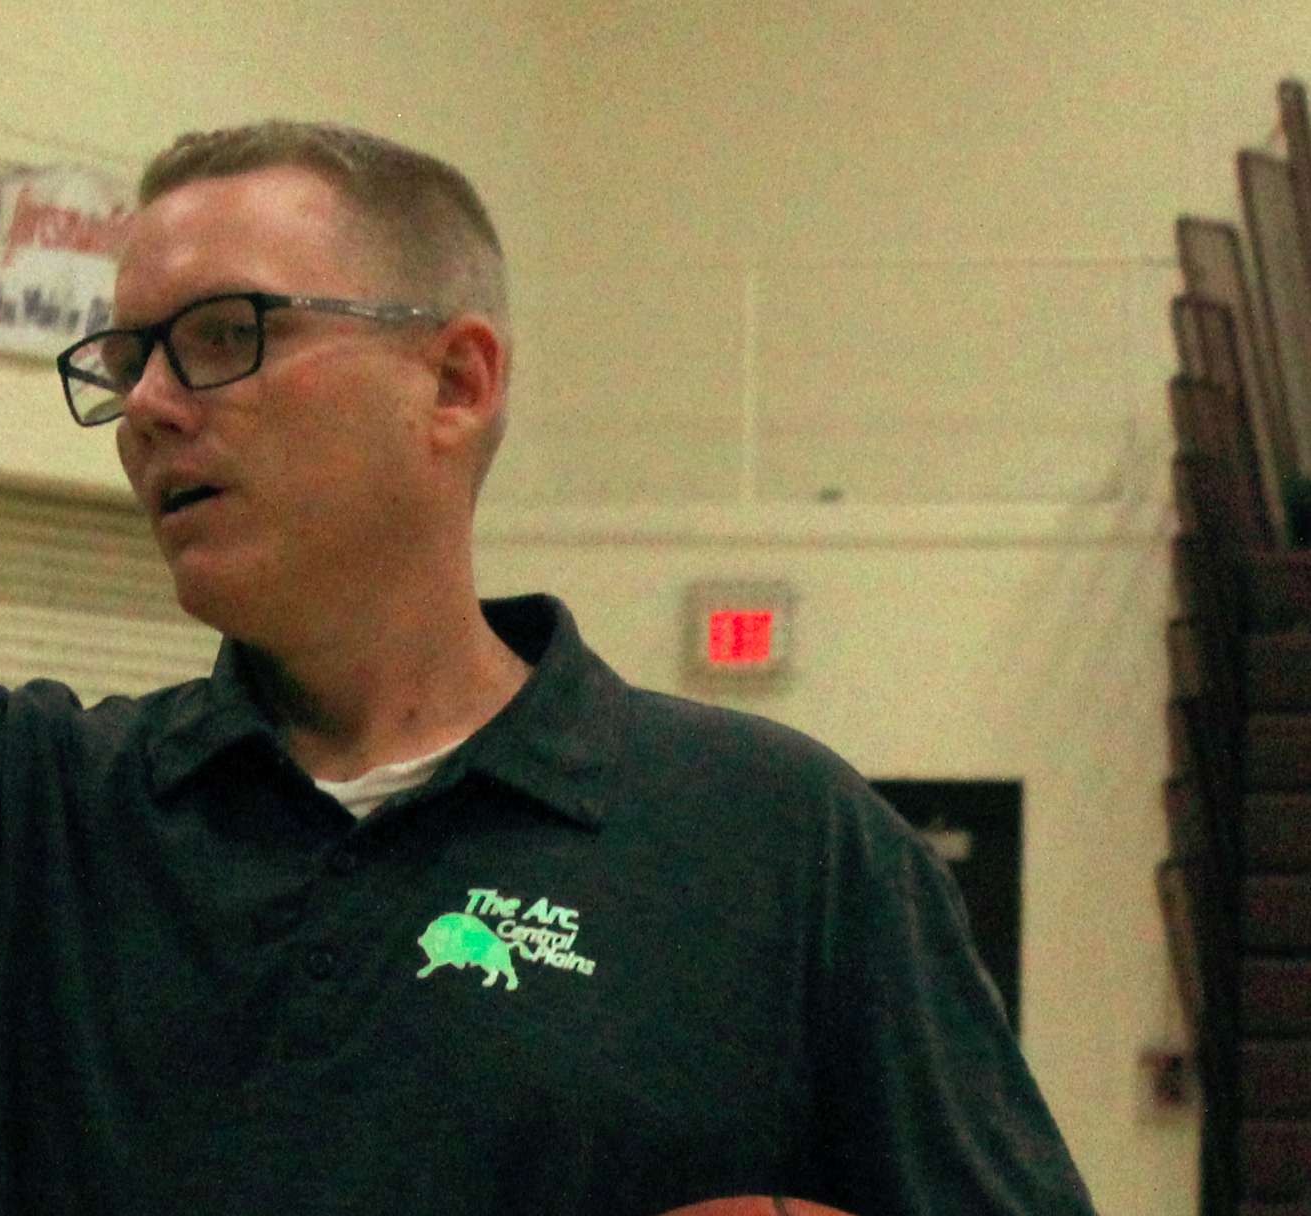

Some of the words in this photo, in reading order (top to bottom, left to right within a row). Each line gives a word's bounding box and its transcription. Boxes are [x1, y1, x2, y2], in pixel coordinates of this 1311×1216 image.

[465, 887, 522, 918] The
[521, 896, 579, 932] Arc
[496, 919, 578, 951] Central
